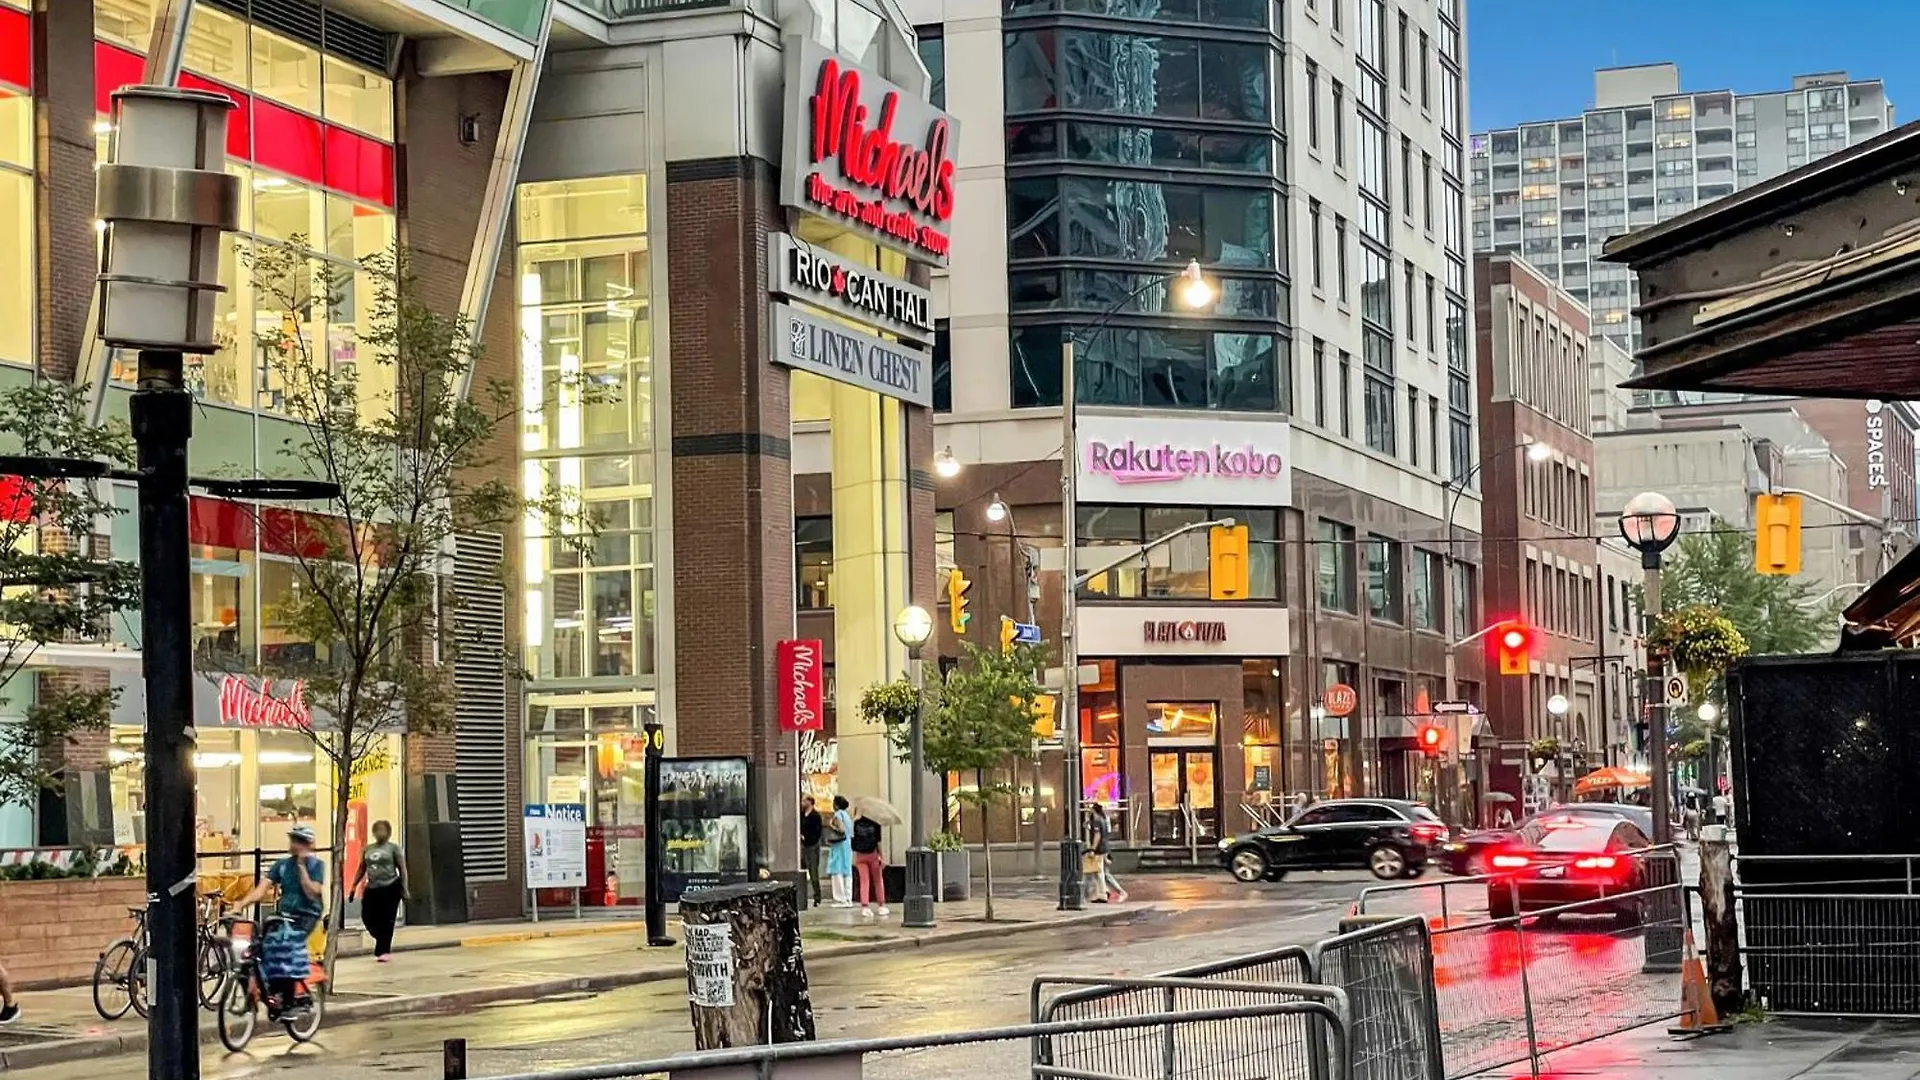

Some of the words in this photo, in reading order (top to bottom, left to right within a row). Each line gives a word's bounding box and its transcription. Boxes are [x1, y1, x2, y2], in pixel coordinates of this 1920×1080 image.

[810, 57, 956, 221] Michaels
[811, 173, 832, 206] the
[834, 191, 860, 218] arts
[860, 202, 886, 229] and
[886, 211, 919, 244] crafts
[796, 249, 832, 291] RIO
[846, 270, 888, 314] CAN
[892, 286, 935, 332] HALL
[808, 323, 865, 376] LINEN
[867, 344, 922, 394] CHEST
[1089, 440, 1211, 476] Rakuten
[1215, 443, 1283, 477] kobo
[792, 643, 816, 728] Michaels
[545, 803, 582, 821] Notice
